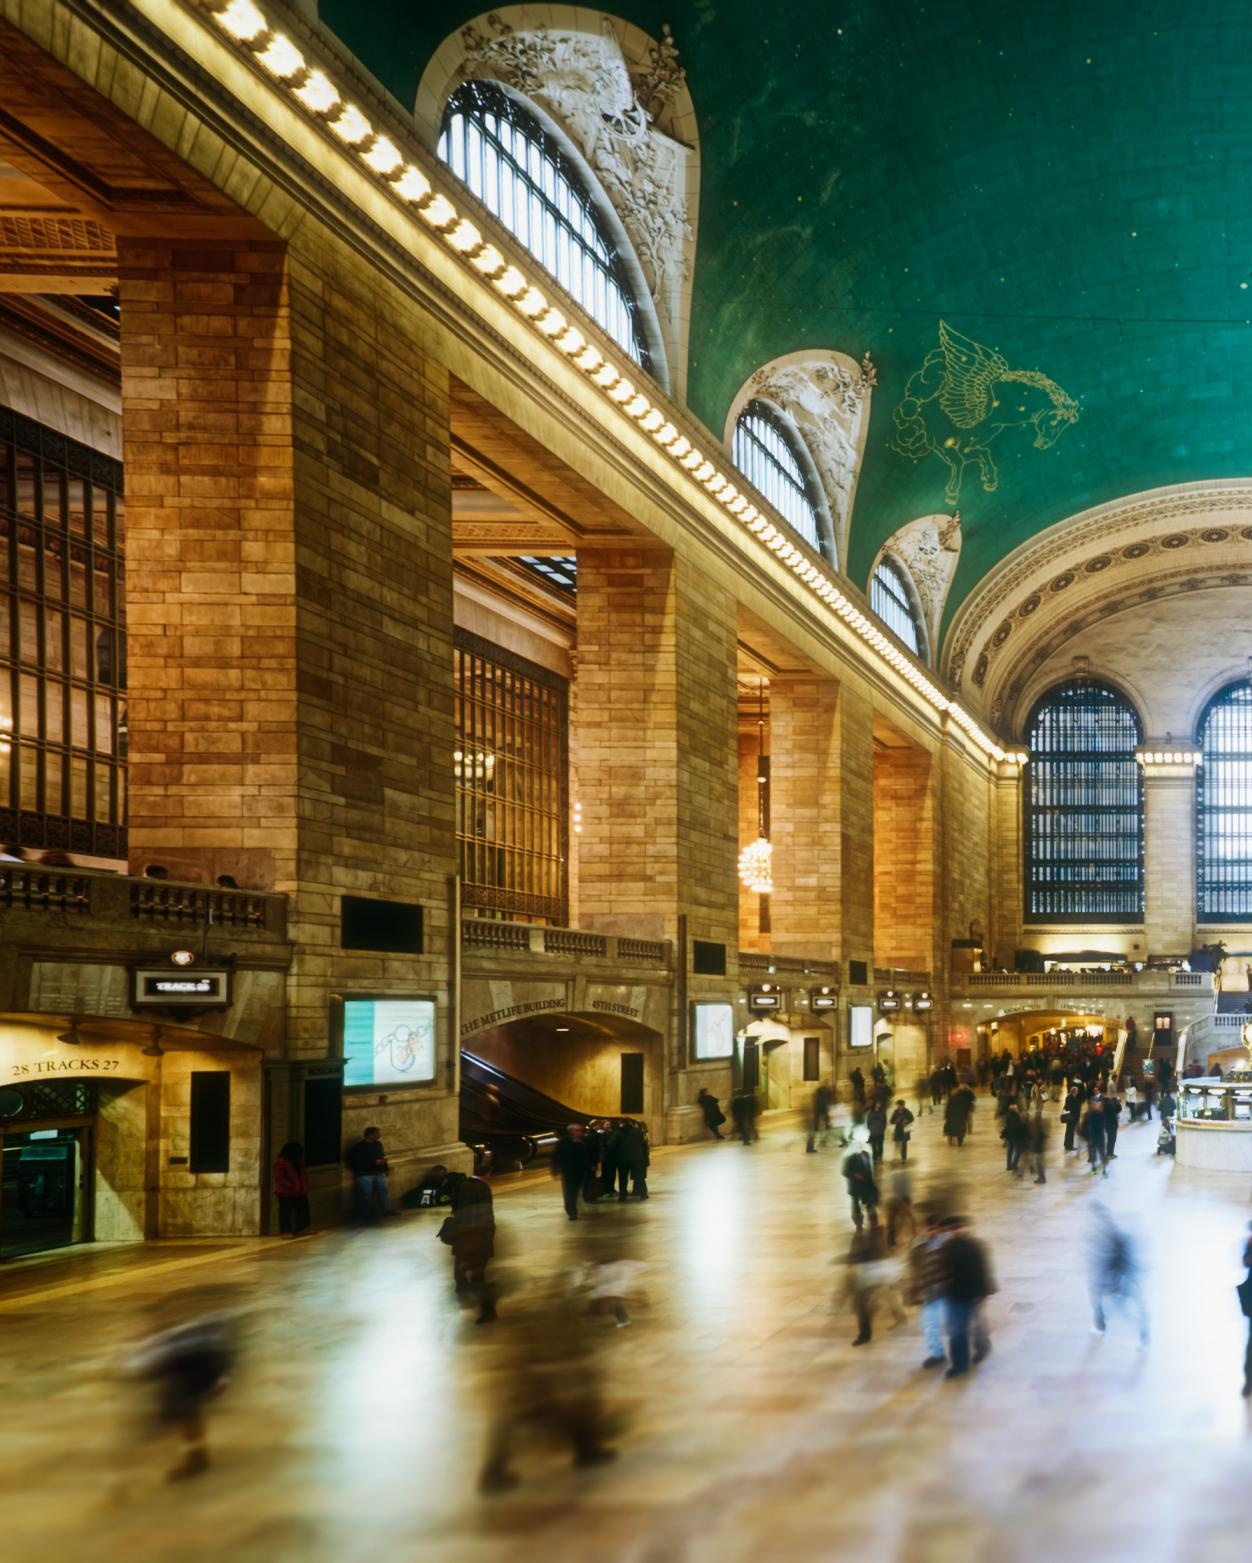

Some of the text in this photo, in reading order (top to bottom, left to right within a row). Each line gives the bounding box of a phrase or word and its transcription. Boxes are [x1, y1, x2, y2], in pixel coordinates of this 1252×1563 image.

[480, 1005, 523, 1026] METLIFE
[523, 999, 567, 1015] BUILDING
[611, 1002, 640, 1018] STREET
[12, 1059, 120, 1076] 28 TRACKS 27
